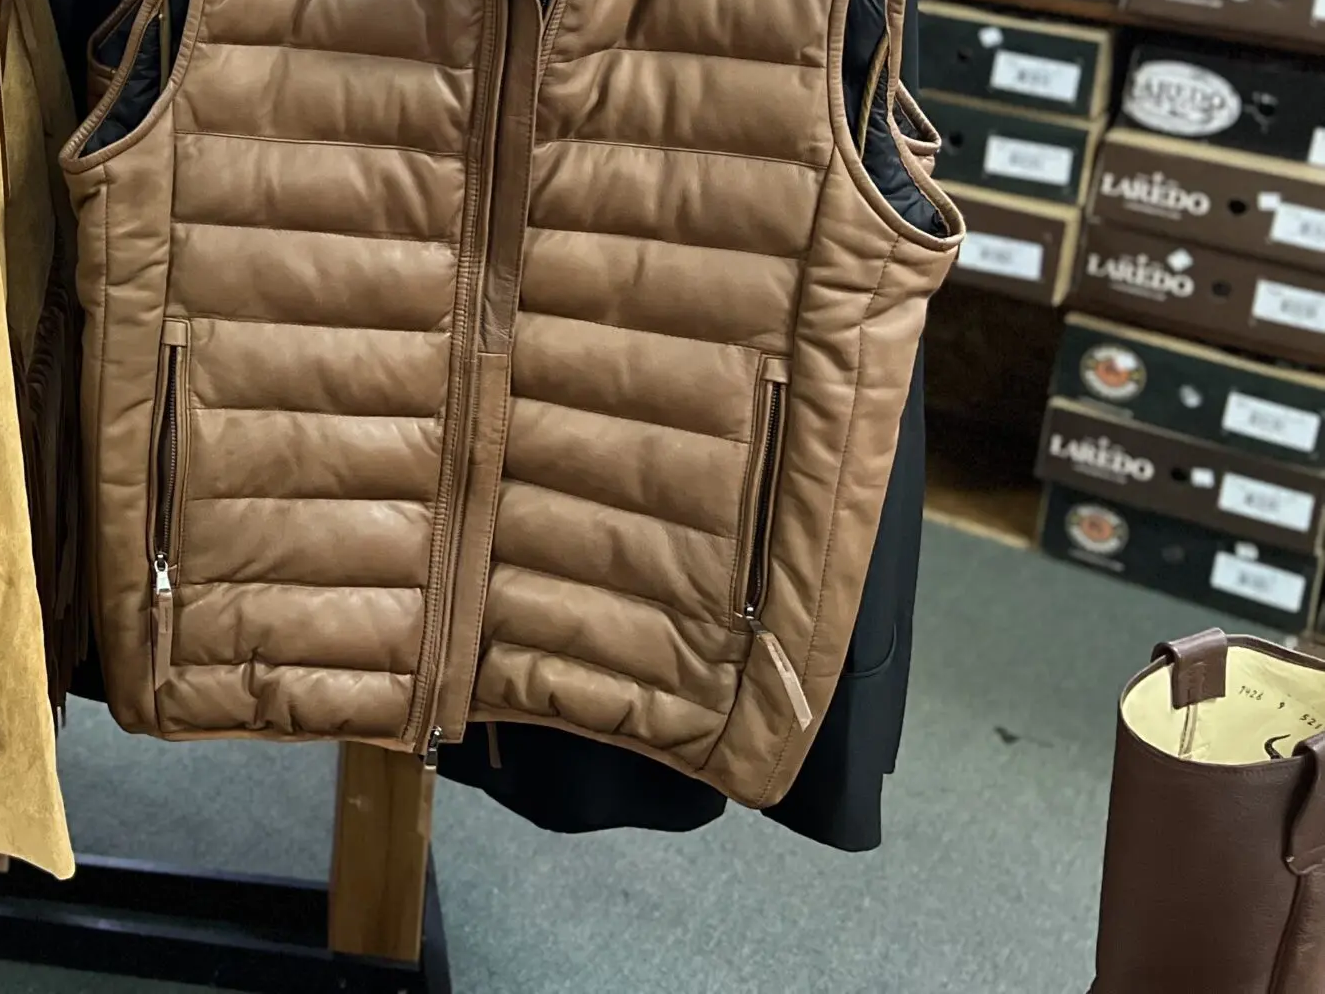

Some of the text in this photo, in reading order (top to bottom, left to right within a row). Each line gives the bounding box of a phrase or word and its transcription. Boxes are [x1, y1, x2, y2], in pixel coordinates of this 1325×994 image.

[1101, 173, 1211, 216] LAREDO
[1087, 253, 1194, 298] LAREDO
[1050, 434, 1155, 481] LAREDO
